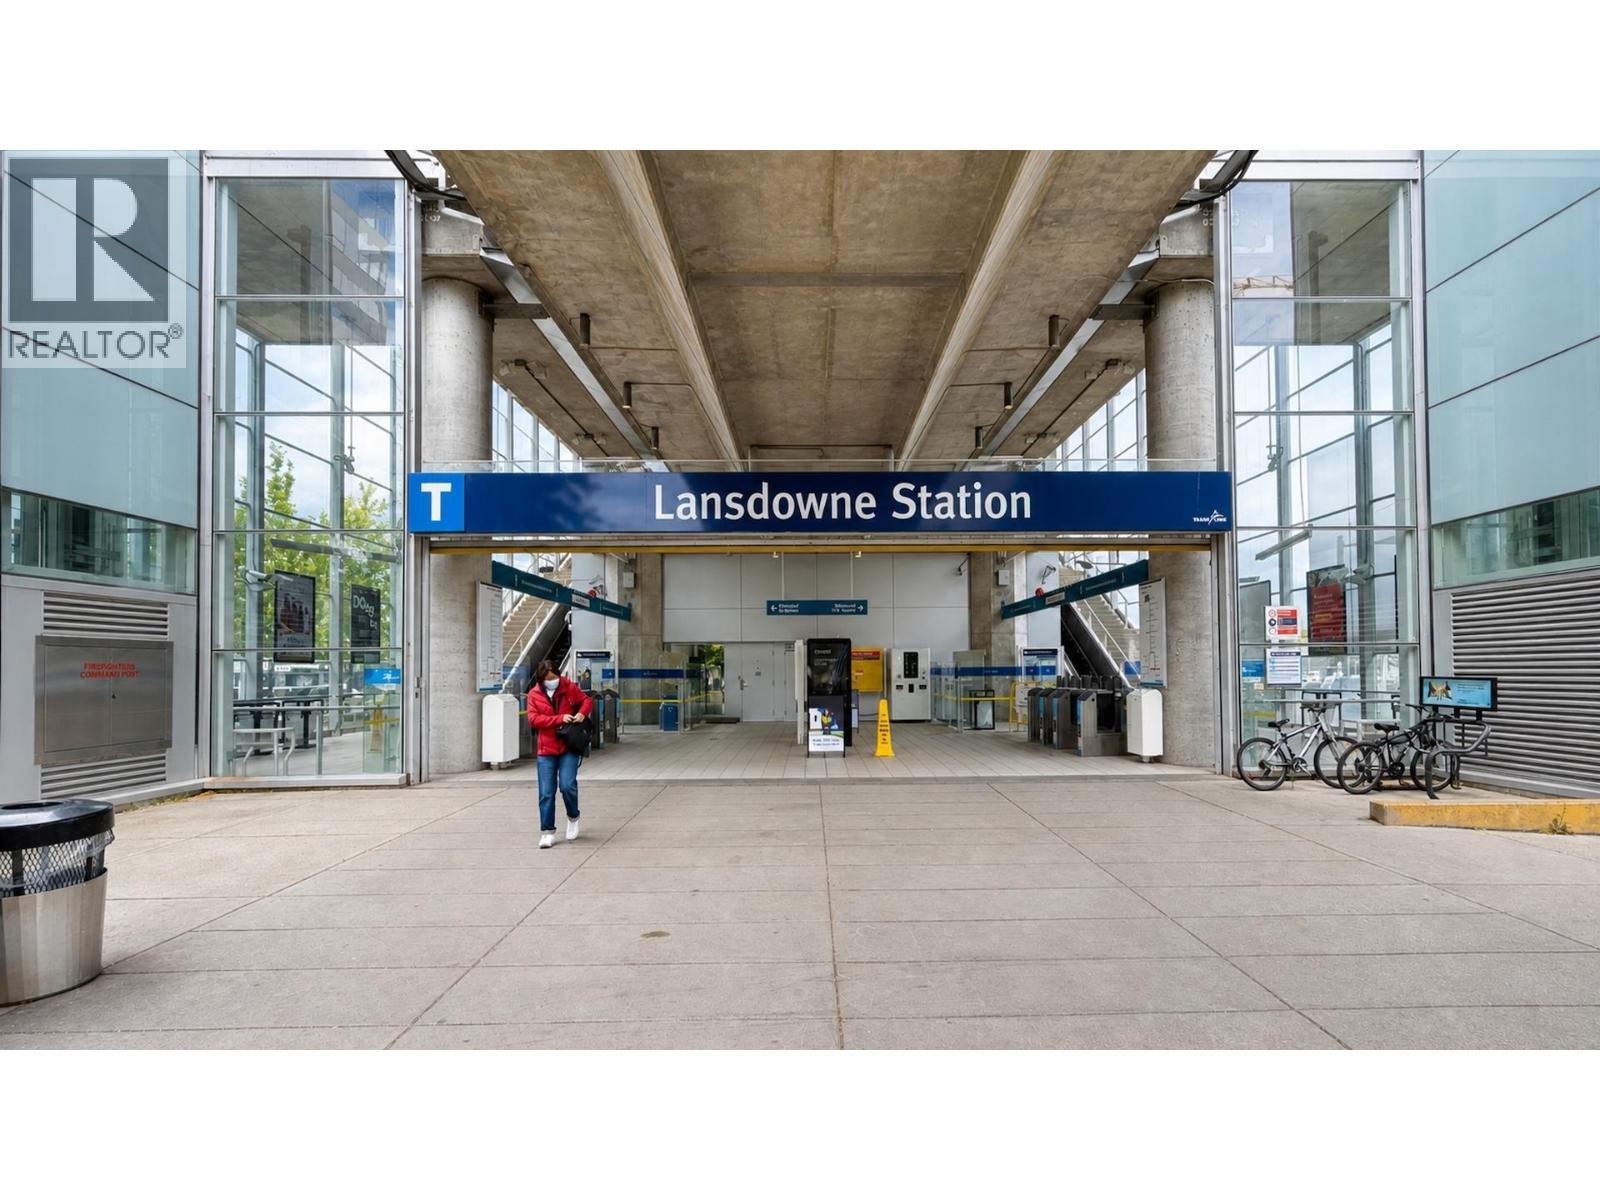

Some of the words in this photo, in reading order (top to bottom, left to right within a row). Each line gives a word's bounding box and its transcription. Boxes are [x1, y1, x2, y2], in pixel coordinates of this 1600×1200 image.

[420, 482, 452, 521] T
[655, 481, 876, 521] Lansdowne
[892, 481, 1032, 520] Station
